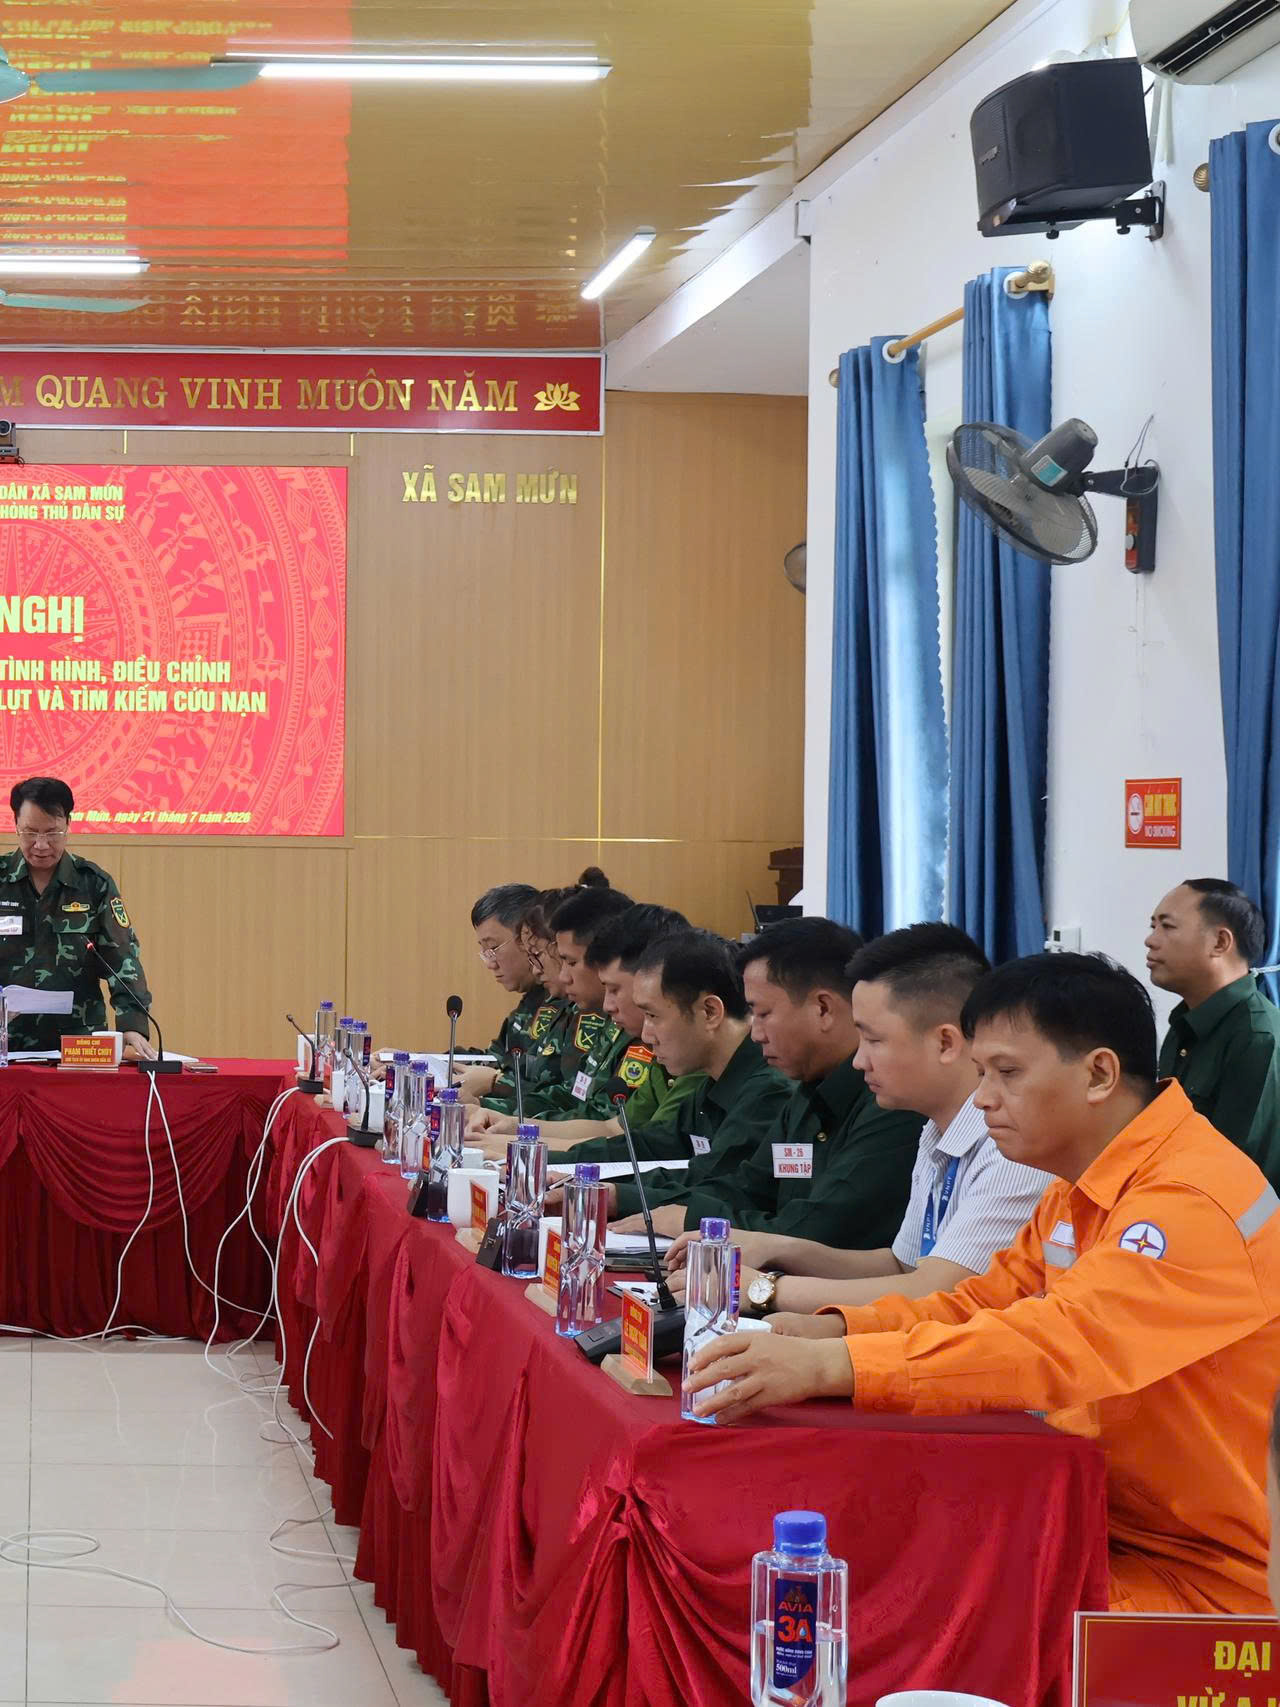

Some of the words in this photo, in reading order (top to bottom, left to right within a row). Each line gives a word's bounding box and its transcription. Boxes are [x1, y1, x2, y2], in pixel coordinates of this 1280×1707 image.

[36, 375, 168, 411] QUANG
[180, 377, 282, 411] VINH
[298, 367, 415, 412] MUÔN
[428, 368, 518, 412] NĂM
[0, 482, 28, 500] DÂN
[32, 483, 51, 500] XÃ
[55, 485, 86, 500] SAM
[90, 483, 123, 500] MỨN
[402, 464, 437, 502] XÃ
[447, 472, 507, 503] SAM
[516, 466, 577, 504] MỨN
[42, 501, 68, 519] THỦ
[72, 503, 101, 519] DÂN
[105, 504, 126, 524] SỰ
[51, 656, 107, 684] HÌNH,
[113, 654, 161, 682] ĐIỀU
[166, 655, 231, 683] CHỈNH
[38, 685, 65, 711] VÀ
[71, 685, 109, 711] TÌM
[114, 684, 167, 712] KIẾM
[173, 687, 215, 712] CỨU
[221, 690, 266, 717] NẠN
[114, 811, 140, 824] ngày
[141, 812, 155, 822] 21
[158, 811, 188, 824] tháng
[190, 812, 198, 823] 7
[198, 812, 222, 823] năm
[778, 1601, 813, 1613] AVIA
[778, 1615, 812, 1642] 3A
[776, 1662, 797, 1674] 500ml
[1214, 1641, 1271, 1677] ĐẠI
